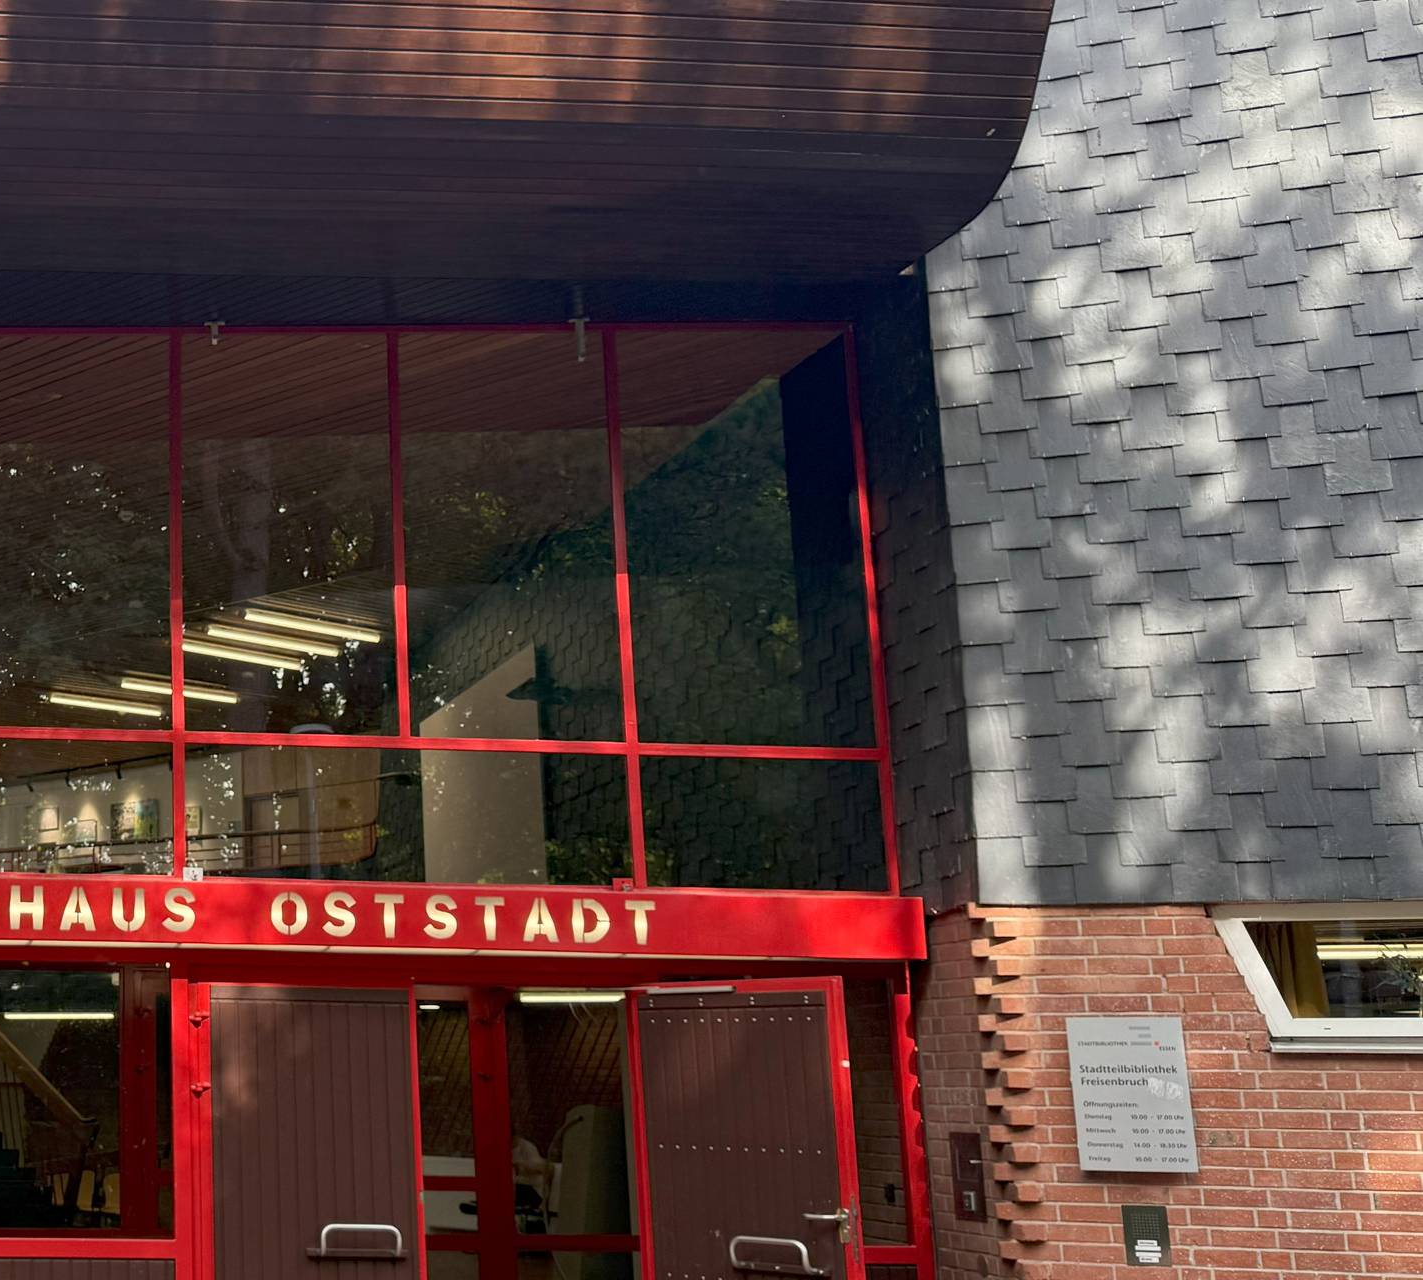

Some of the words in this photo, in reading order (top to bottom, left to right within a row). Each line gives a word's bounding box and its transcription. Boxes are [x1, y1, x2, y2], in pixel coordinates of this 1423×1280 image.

[270, 891, 656, 946] OSTSTADT
[1079, 1064, 1178, 1074] Stadtteilbibliothek
[1081, 1077, 1149, 1086] Freisenbruch
[1083, 1100, 1139, 1109] Öffnungszeiten:
[1087, 1141, 1124, 1149] Donnerstag
